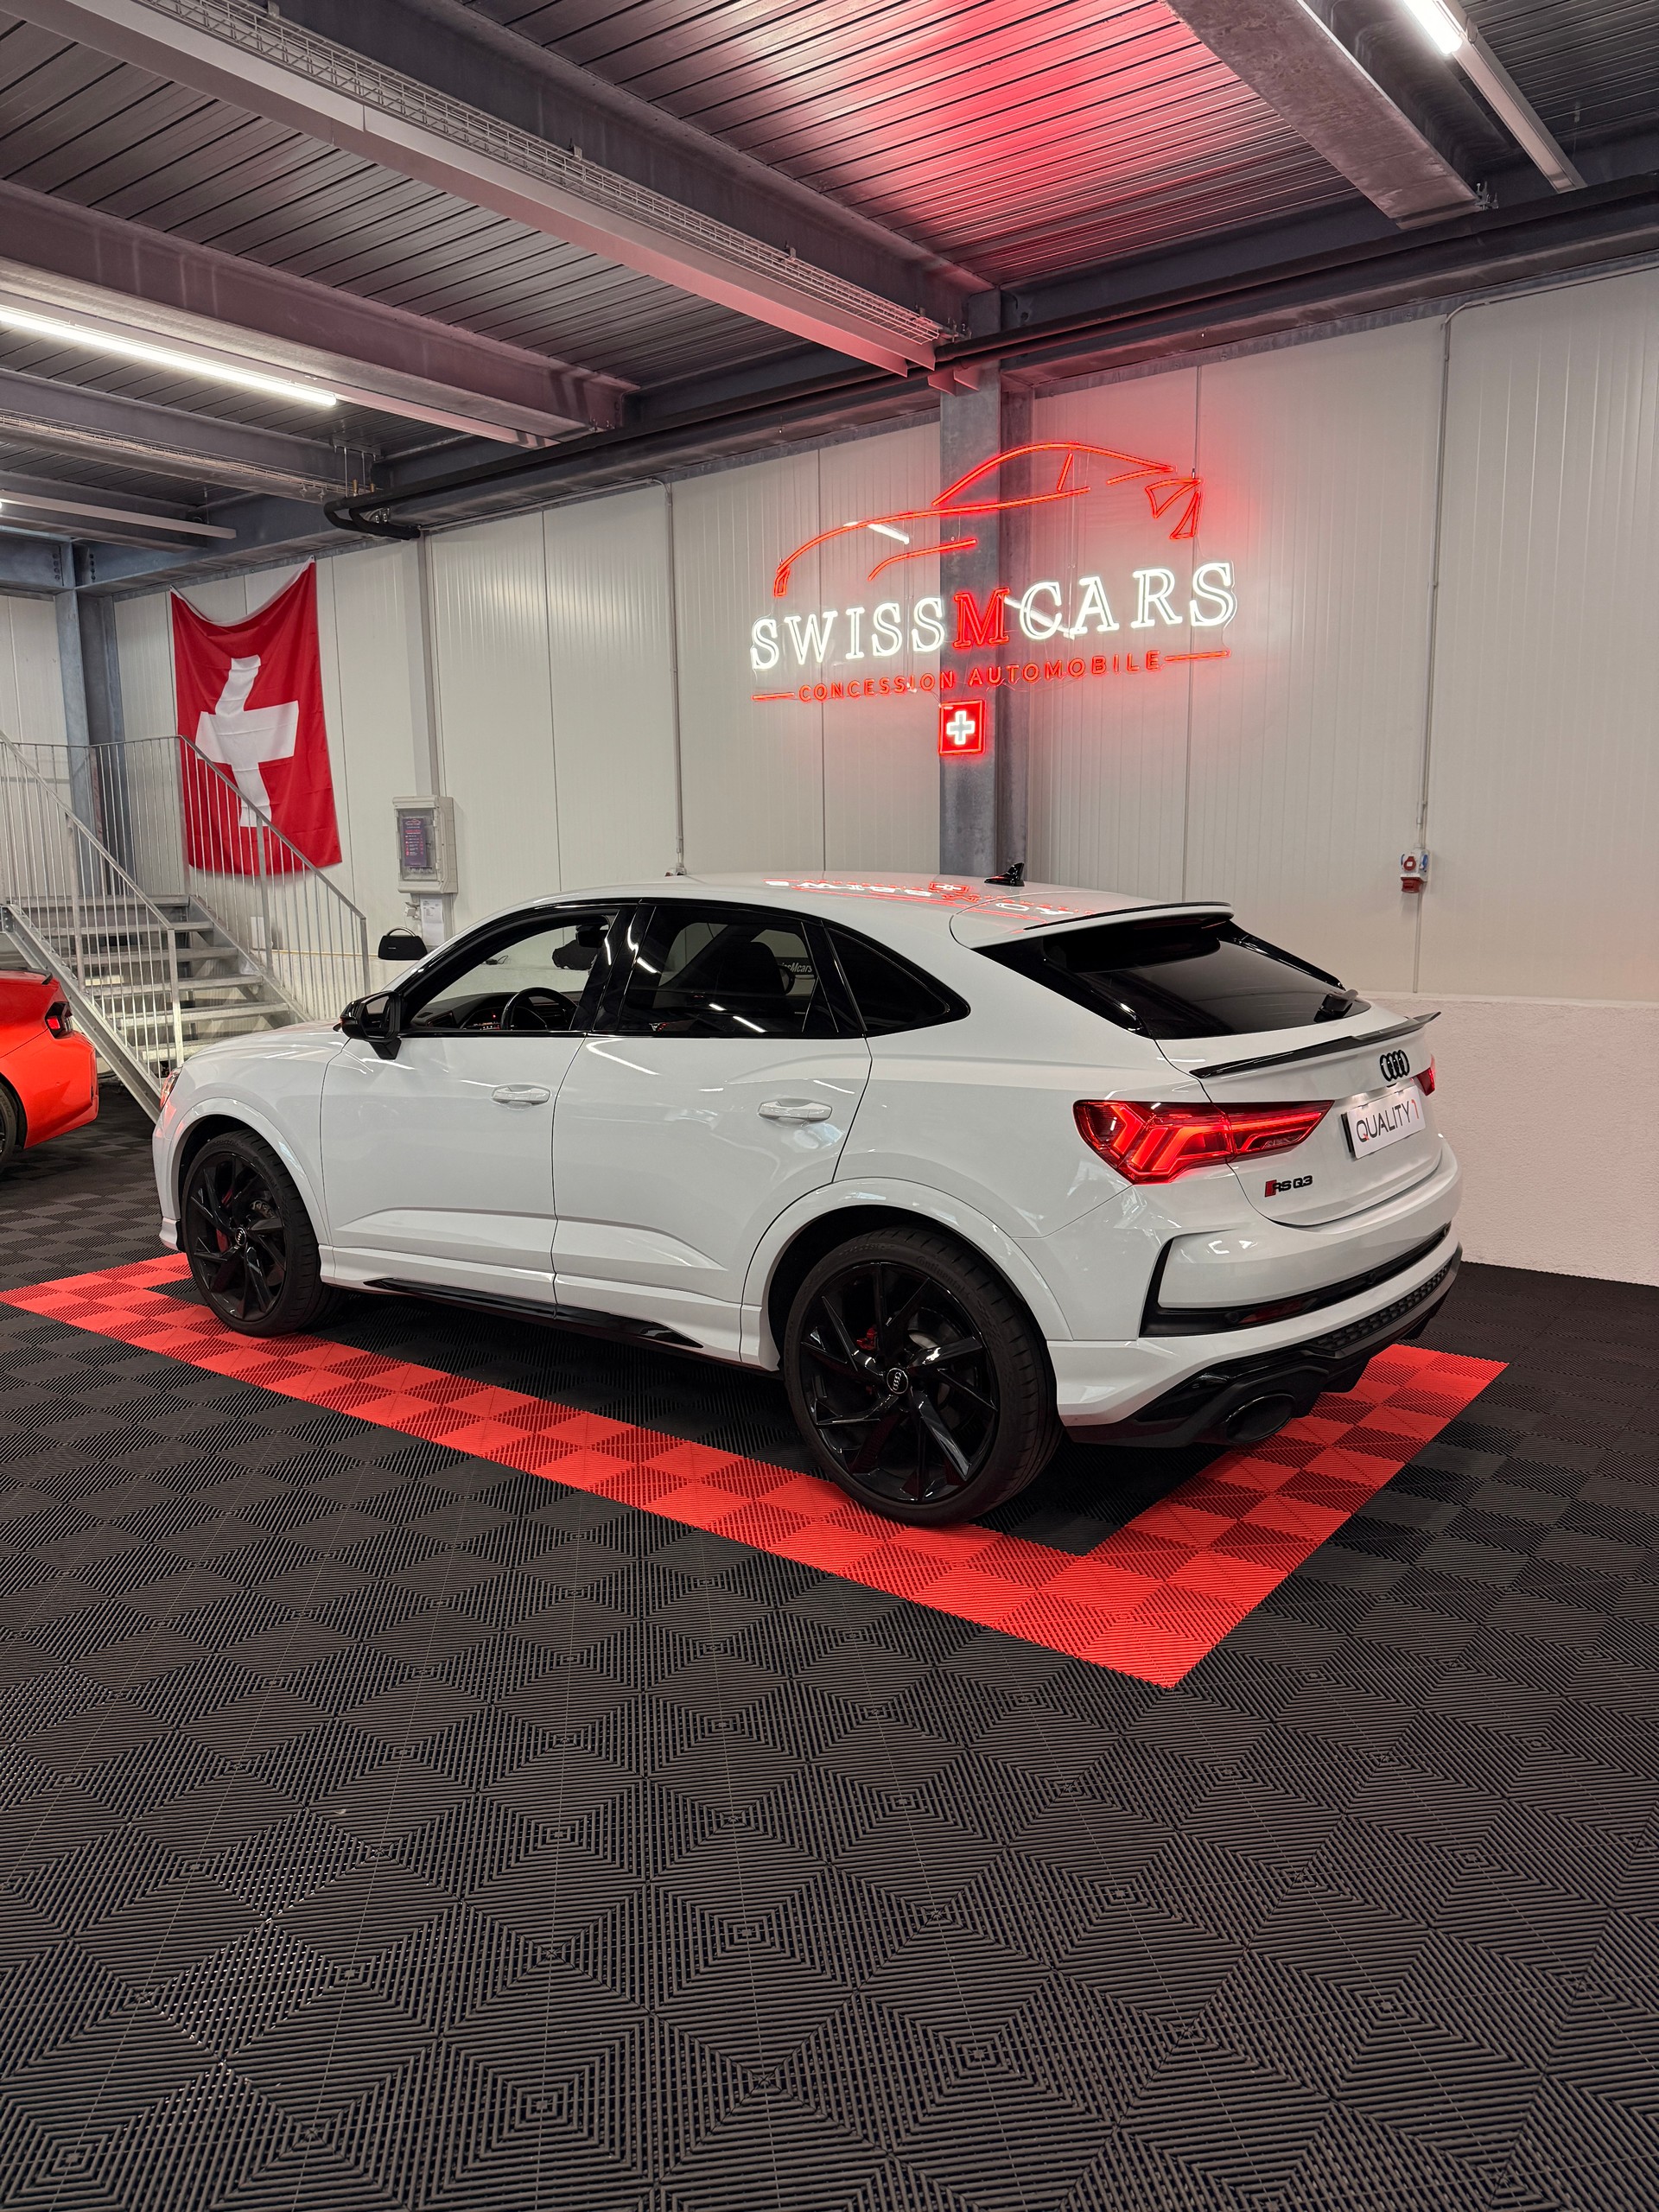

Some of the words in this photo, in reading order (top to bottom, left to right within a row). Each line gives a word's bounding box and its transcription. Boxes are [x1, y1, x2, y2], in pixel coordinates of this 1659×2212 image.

[798, 670, 955, 702] CONCESSION
[969, 651, 1162, 686] AUTOMOBILE
[916, 1255, 965, 1294] Continental
